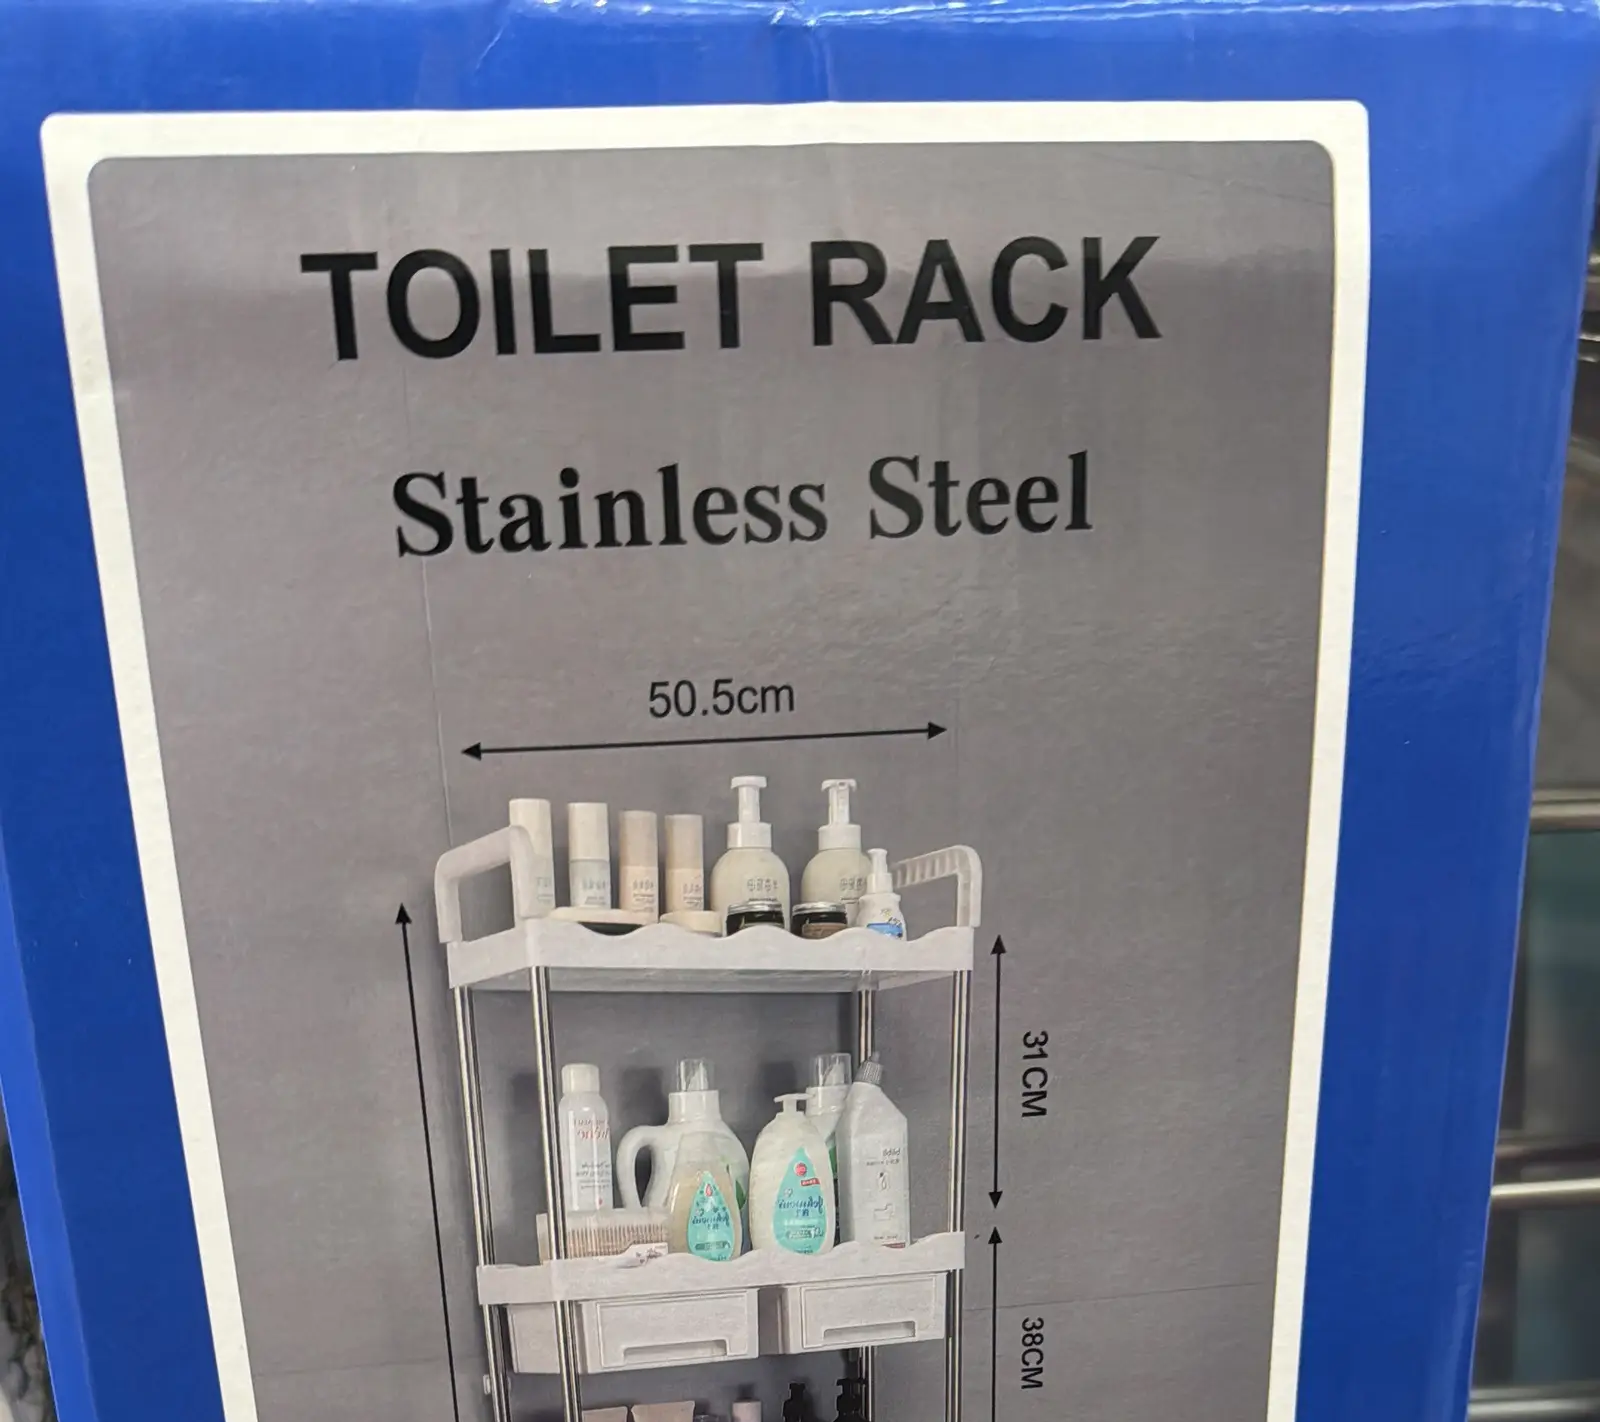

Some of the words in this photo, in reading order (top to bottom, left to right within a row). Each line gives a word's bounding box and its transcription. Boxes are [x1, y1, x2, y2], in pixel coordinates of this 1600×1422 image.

[301, 242, 764, 361] TOILET
[810, 235, 1162, 347] RACK
[392, 462, 828, 558] Stainless
[869, 450, 1093, 540] Steel
[648, 679, 795, 719] 50.5cm
[1020, 1316, 1044, 1391] 38CM
